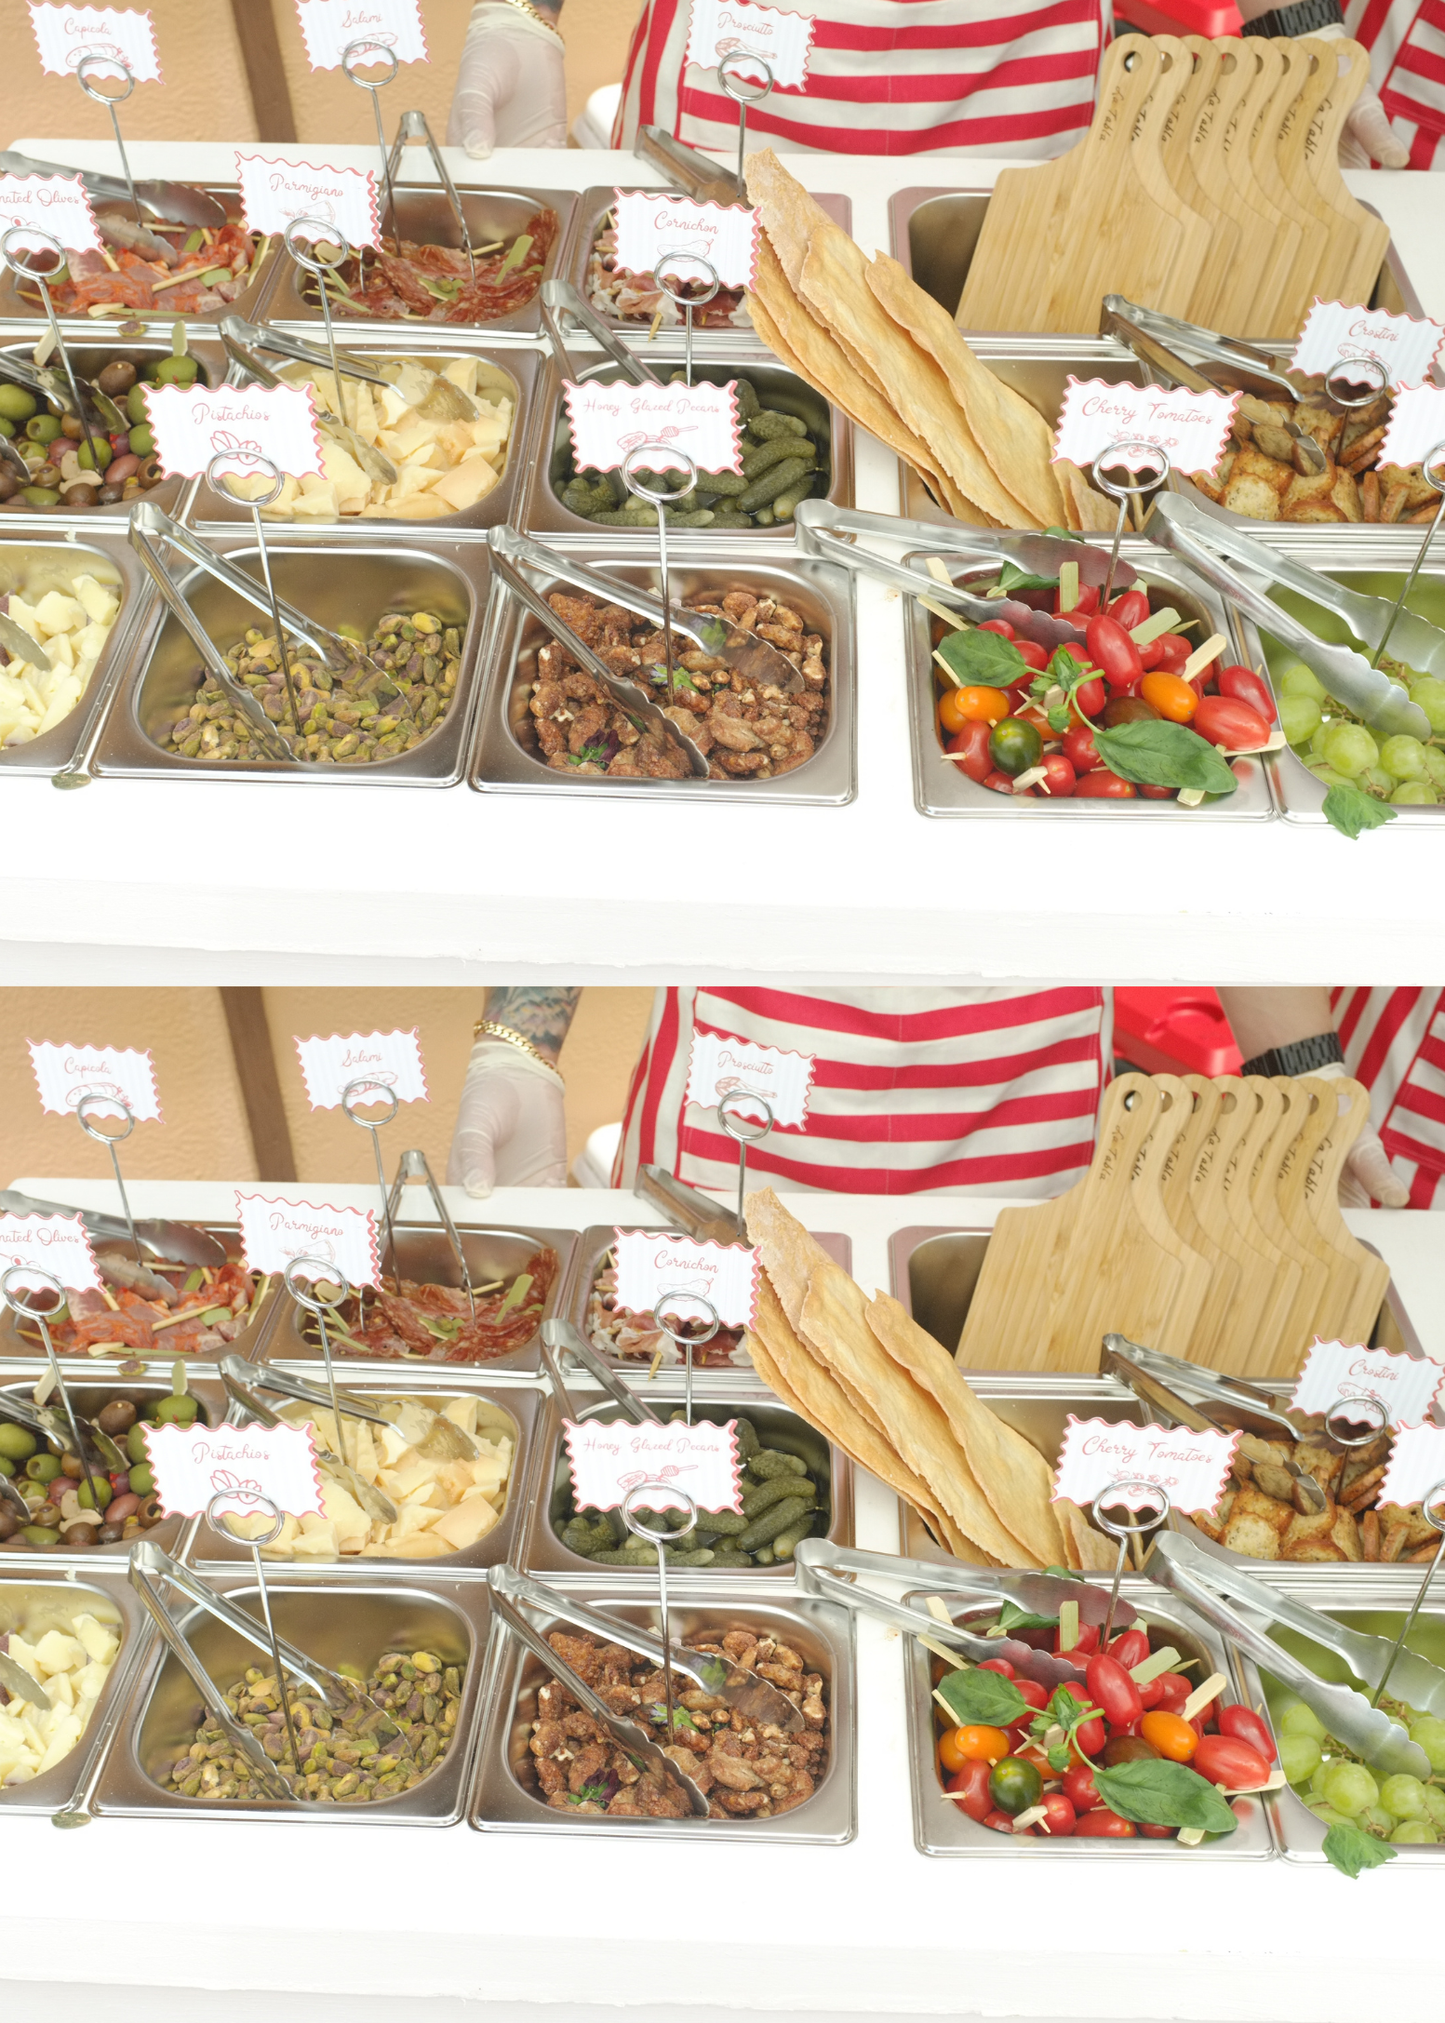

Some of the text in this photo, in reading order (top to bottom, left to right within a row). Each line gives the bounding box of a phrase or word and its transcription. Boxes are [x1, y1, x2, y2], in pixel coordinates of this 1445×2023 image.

[64, 17, 112, 40] Capicola
[341, 10, 382, 28] Salami
[717, 11, 774, 36] Prosciutto
[36, 188, 80, 208] Olives
[269, 173, 344, 200] Parmigiano
[654, 210, 719, 235] Cornichon
[1348, 320, 1401, 342] Crostini
[191, 402, 271, 425] Pistachios
[583, 398, 721, 417] Honey Glazed Pecans
[1082, 396, 1214, 425] Cherry Tomatoes
[64, 1056, 112, 1079] Capicola
[341, 1049, 382, 1067] Salami
[717, 1050, 774, 1075] Prosciutto
[36, 1227, 80, 1247] Olives
[269, 1212, 344, 1239] Parmigiano
[654, 1249, 719, 1274] Cornichon
[1348, 1359, 1401, 1381] Crostini
[191, 1441, 271, 1464] Pistachios
[583, 1437, 721, 1456] Honey Glazed Pecans
[1082, 1435, 1214, 1464] Cherry Tomatoes
